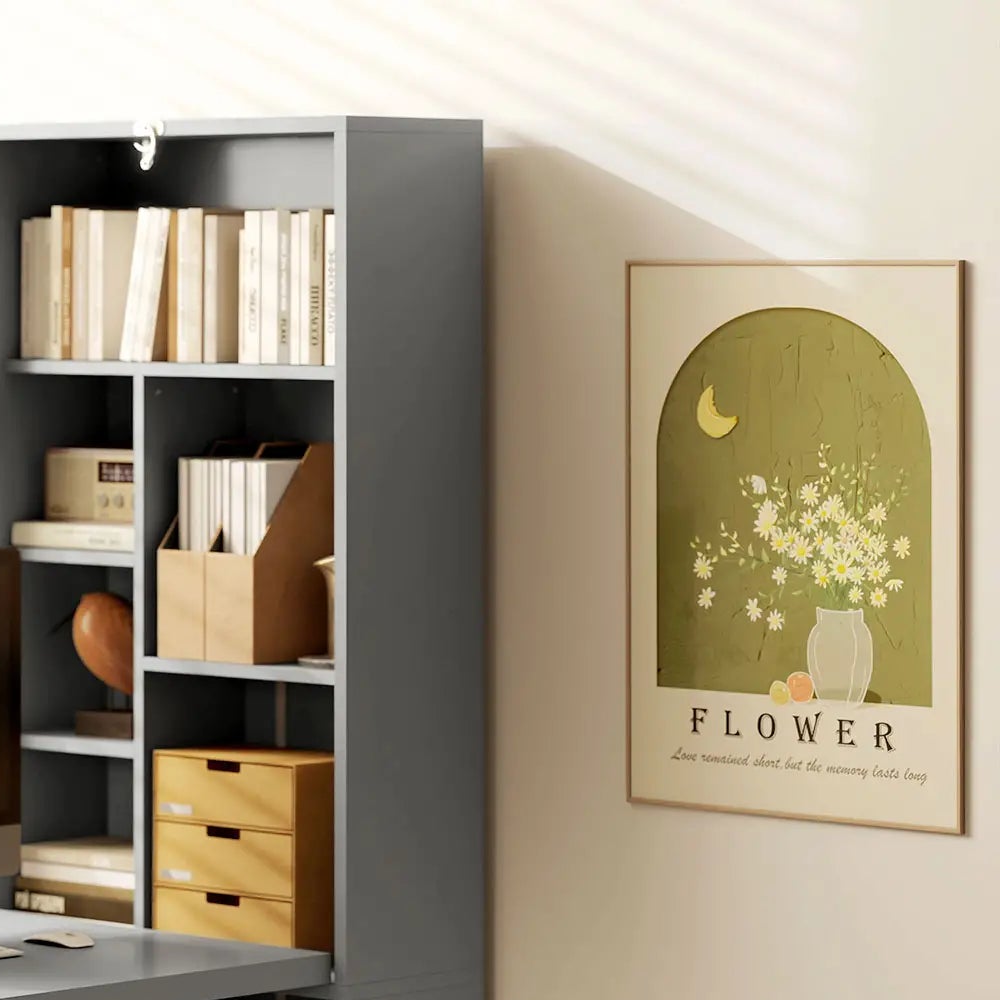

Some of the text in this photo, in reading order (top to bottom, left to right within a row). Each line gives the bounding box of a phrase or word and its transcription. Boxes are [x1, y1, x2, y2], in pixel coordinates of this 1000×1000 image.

[689, 706, 896, 752] FLOWER
[670, 746, 697, 762] Love
[701, 754, 750, 767] remained
[805, 757, 822, 773] the
[826, 763, 869, 780] memory
[872, 764, 900, 780] lasts
[903, 767, 928, 786] long
